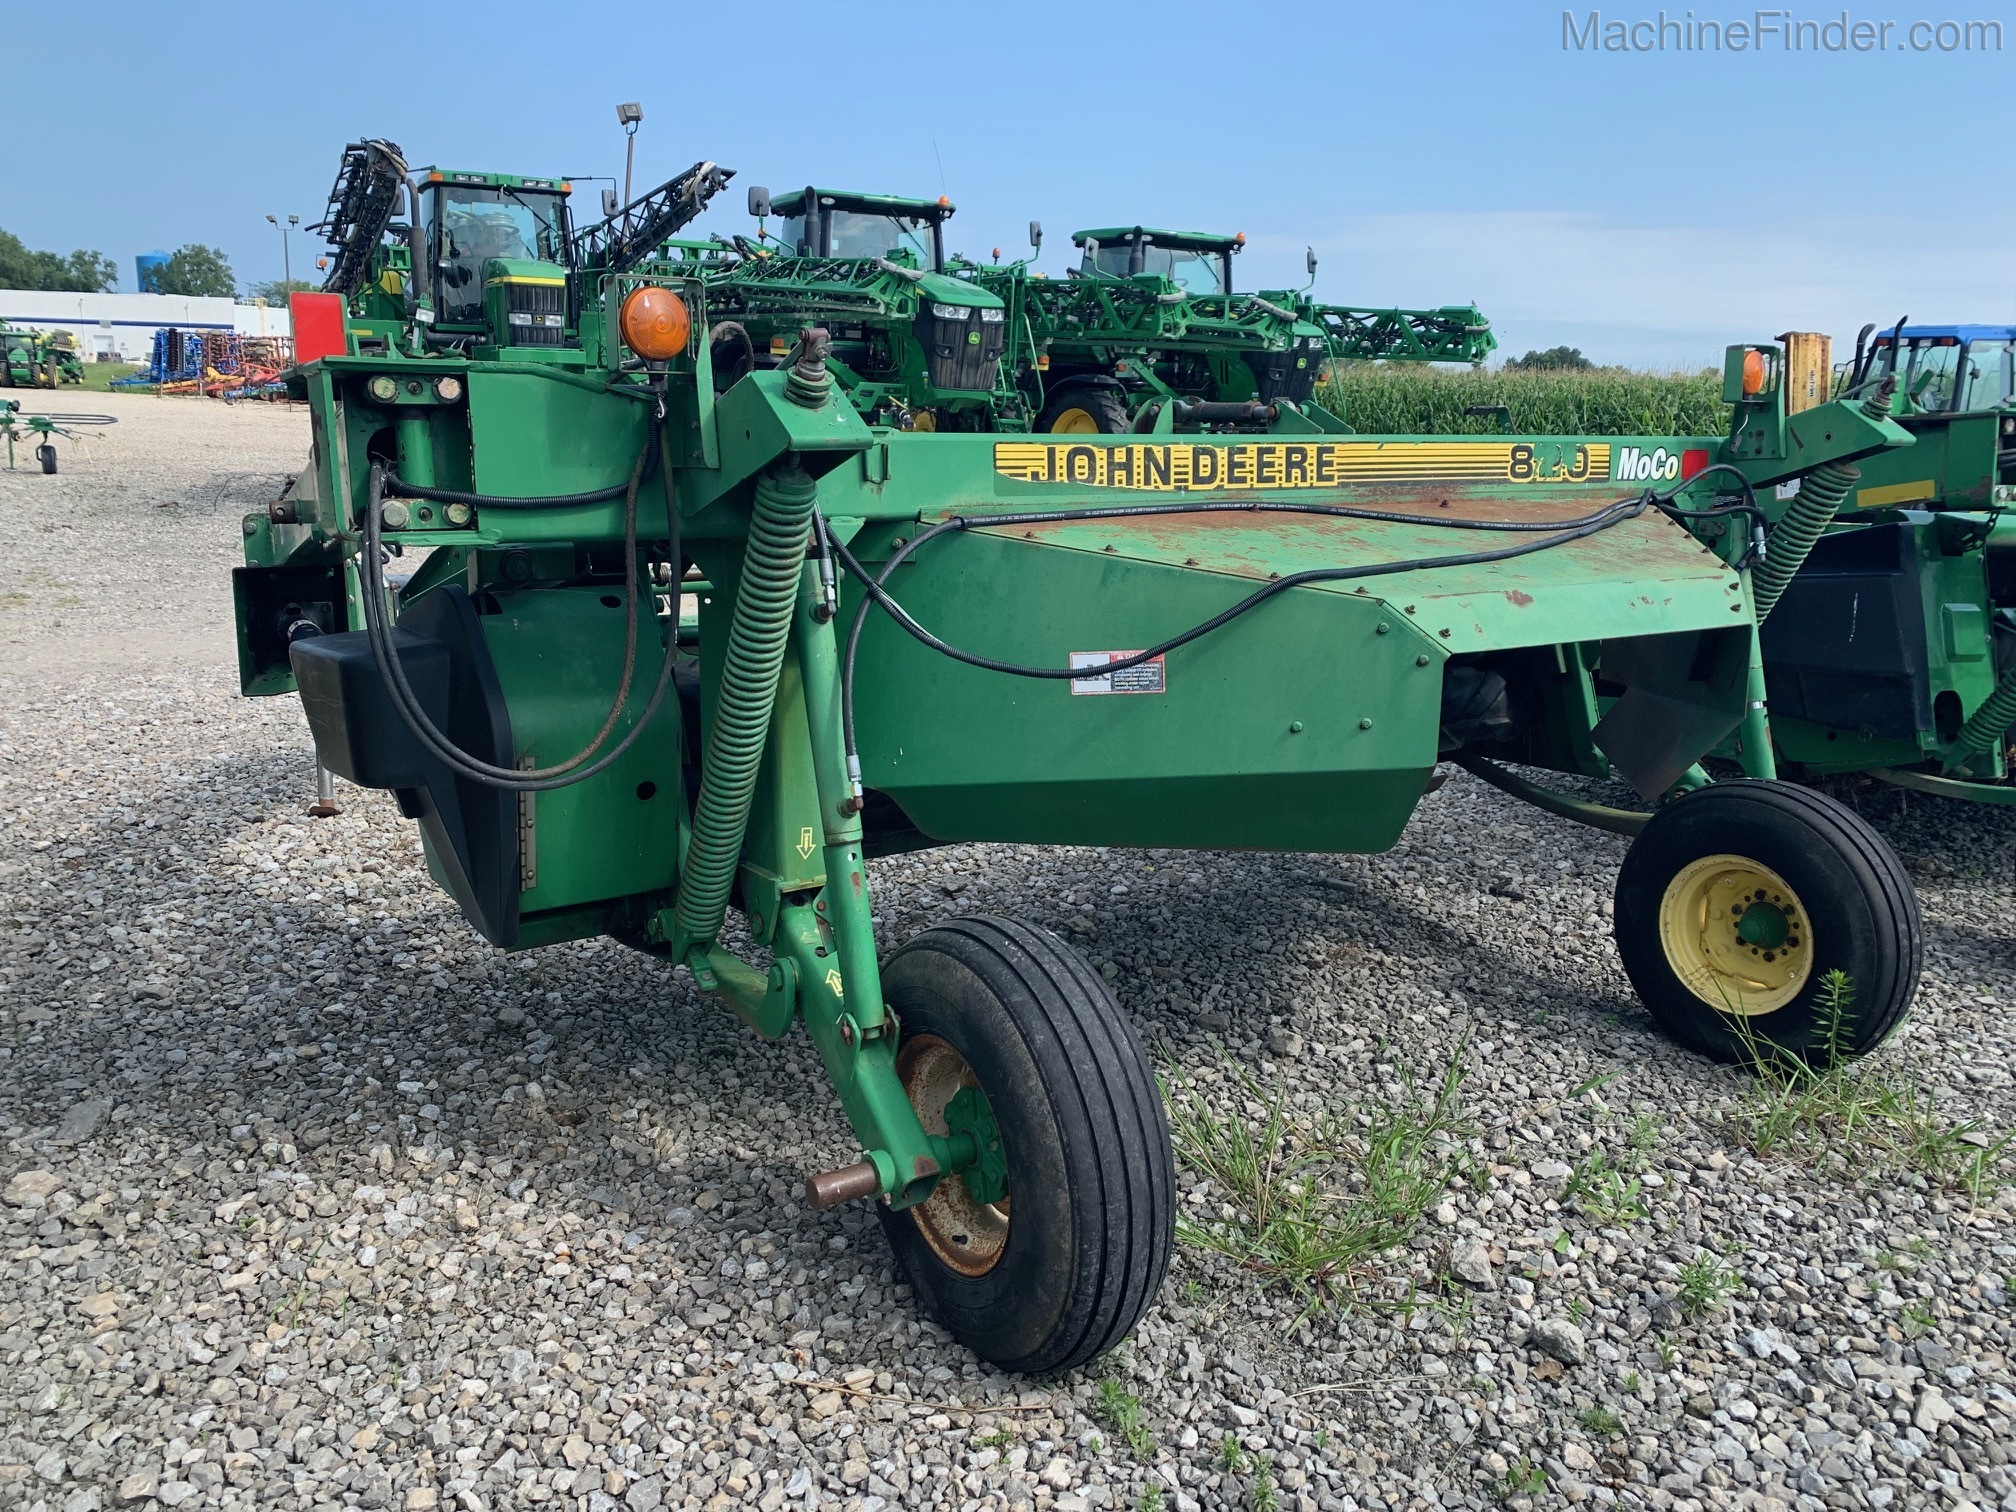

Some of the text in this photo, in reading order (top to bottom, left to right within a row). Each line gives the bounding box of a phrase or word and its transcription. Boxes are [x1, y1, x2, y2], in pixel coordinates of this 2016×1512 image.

[1029, 444, 1680, 488] JOHN DEERE 80 MoCo
